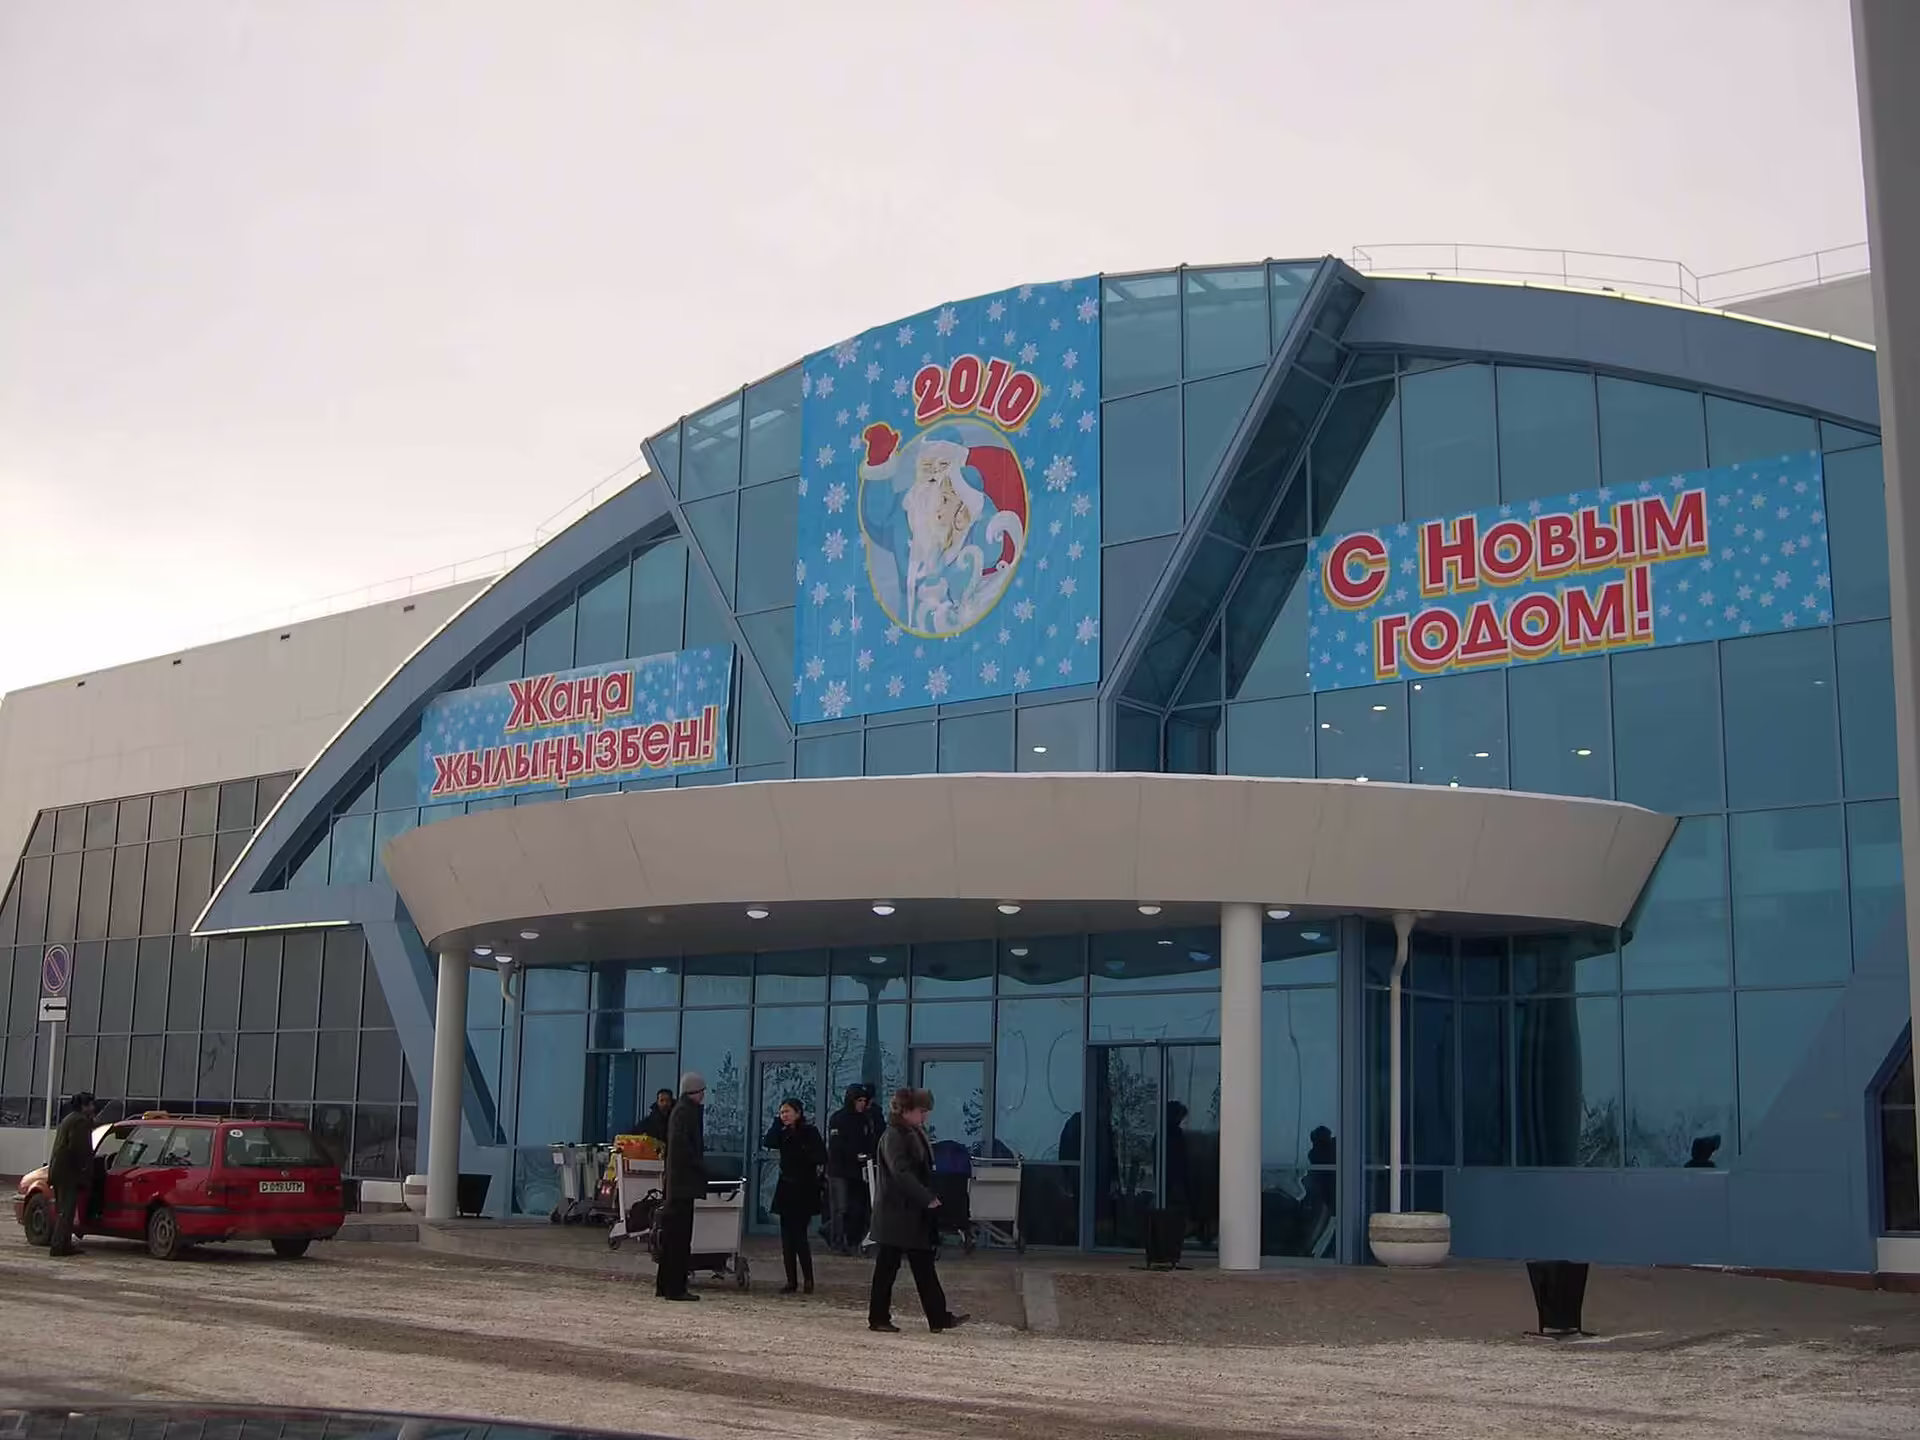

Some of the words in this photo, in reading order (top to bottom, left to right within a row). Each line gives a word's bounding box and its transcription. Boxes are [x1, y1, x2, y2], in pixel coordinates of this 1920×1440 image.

[914, 354, 1041, 431] 2010
[1324, 531, 1389, 607] С
[1420, 487, 1708, 596] Новым
[504, 670, 635, 733] Жаңа
